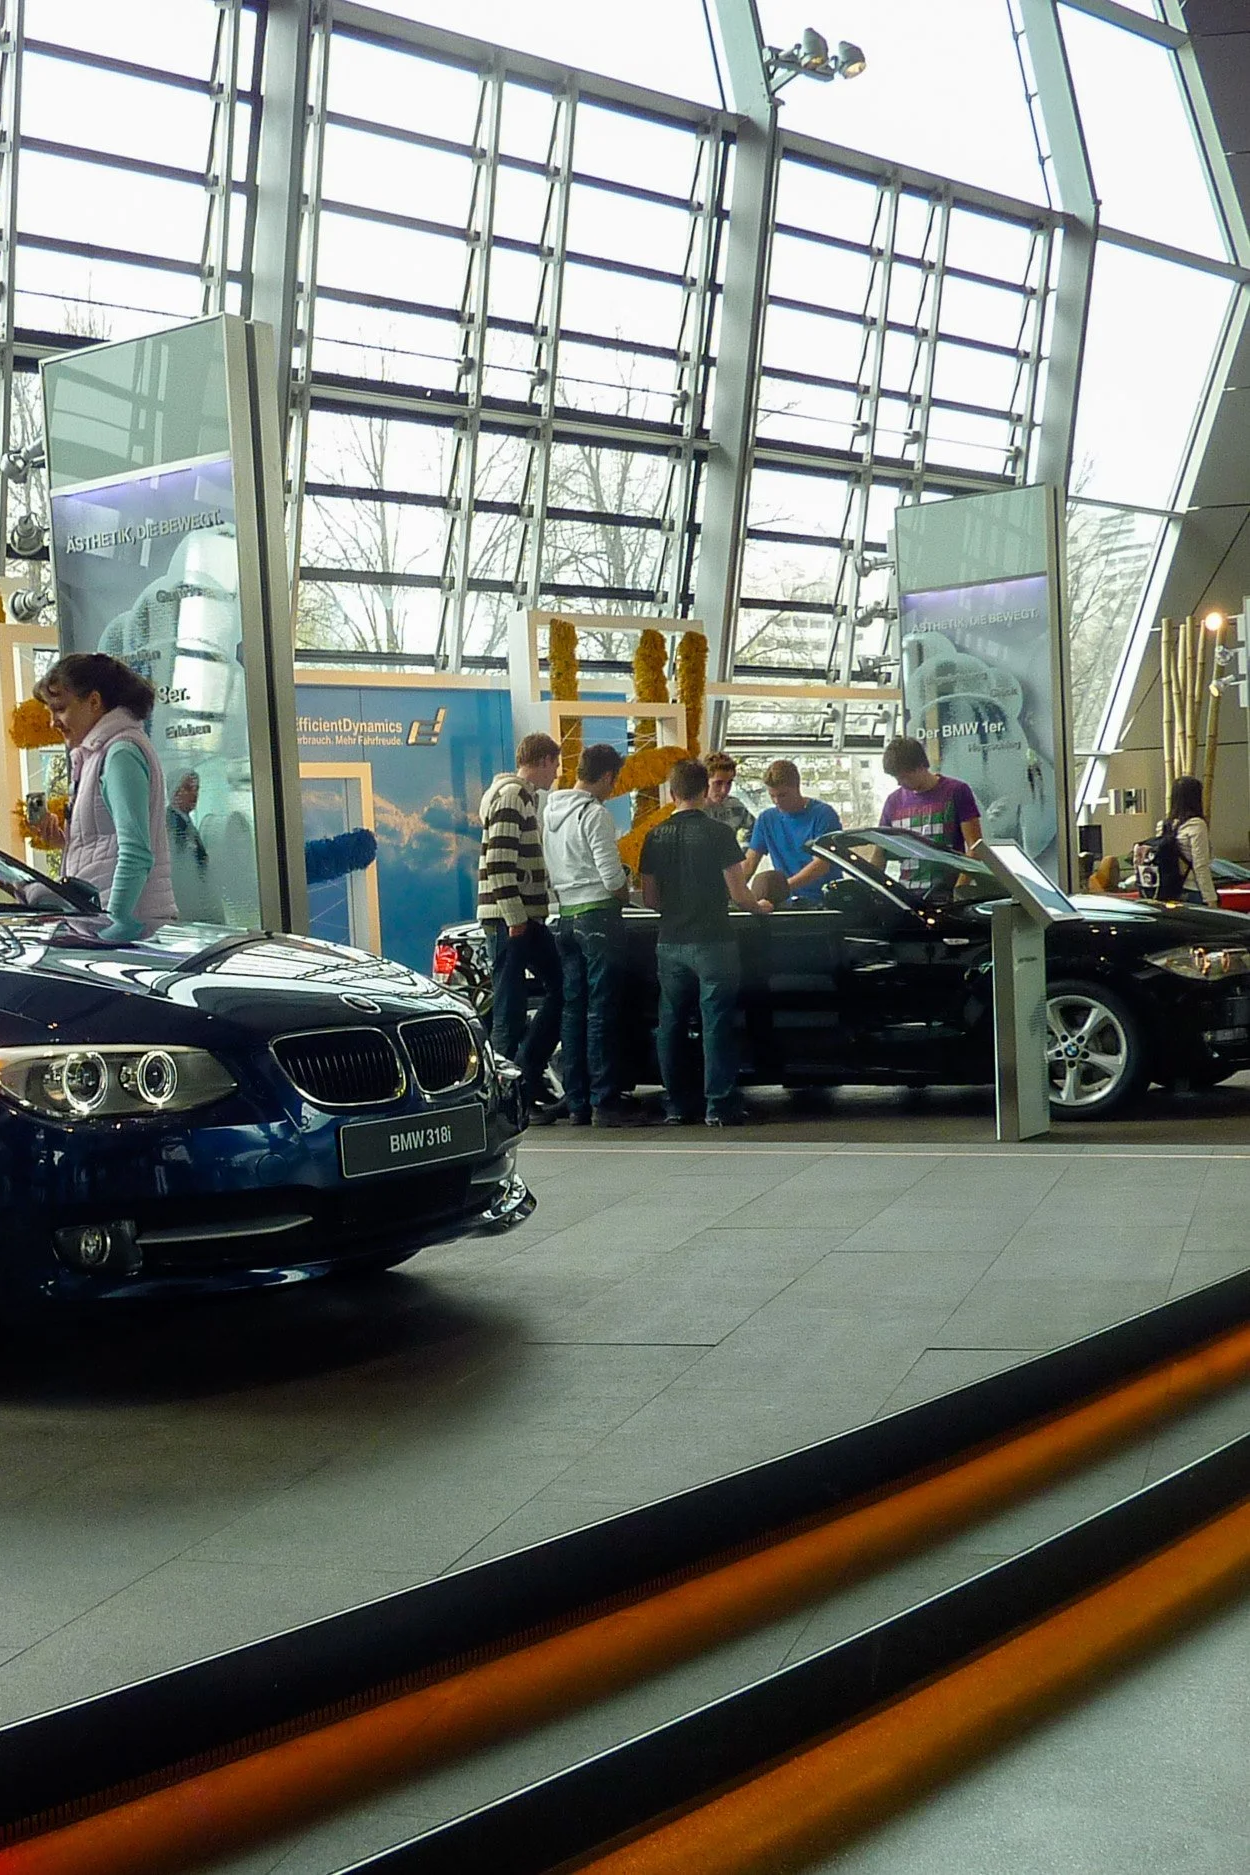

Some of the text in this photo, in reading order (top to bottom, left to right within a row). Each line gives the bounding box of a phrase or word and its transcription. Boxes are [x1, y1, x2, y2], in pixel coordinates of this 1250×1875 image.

[66, 527, 136, 554] ÄSTHETIK,
[136, 523, 159, 541] DIE
[157, 685, 191, 705] 3er.
[335, 735, 356, 746] Mehr
[916, 721, 1006, 740] Der BMW 1er.
[390, 1125, 452, 1153] BMW 318i
